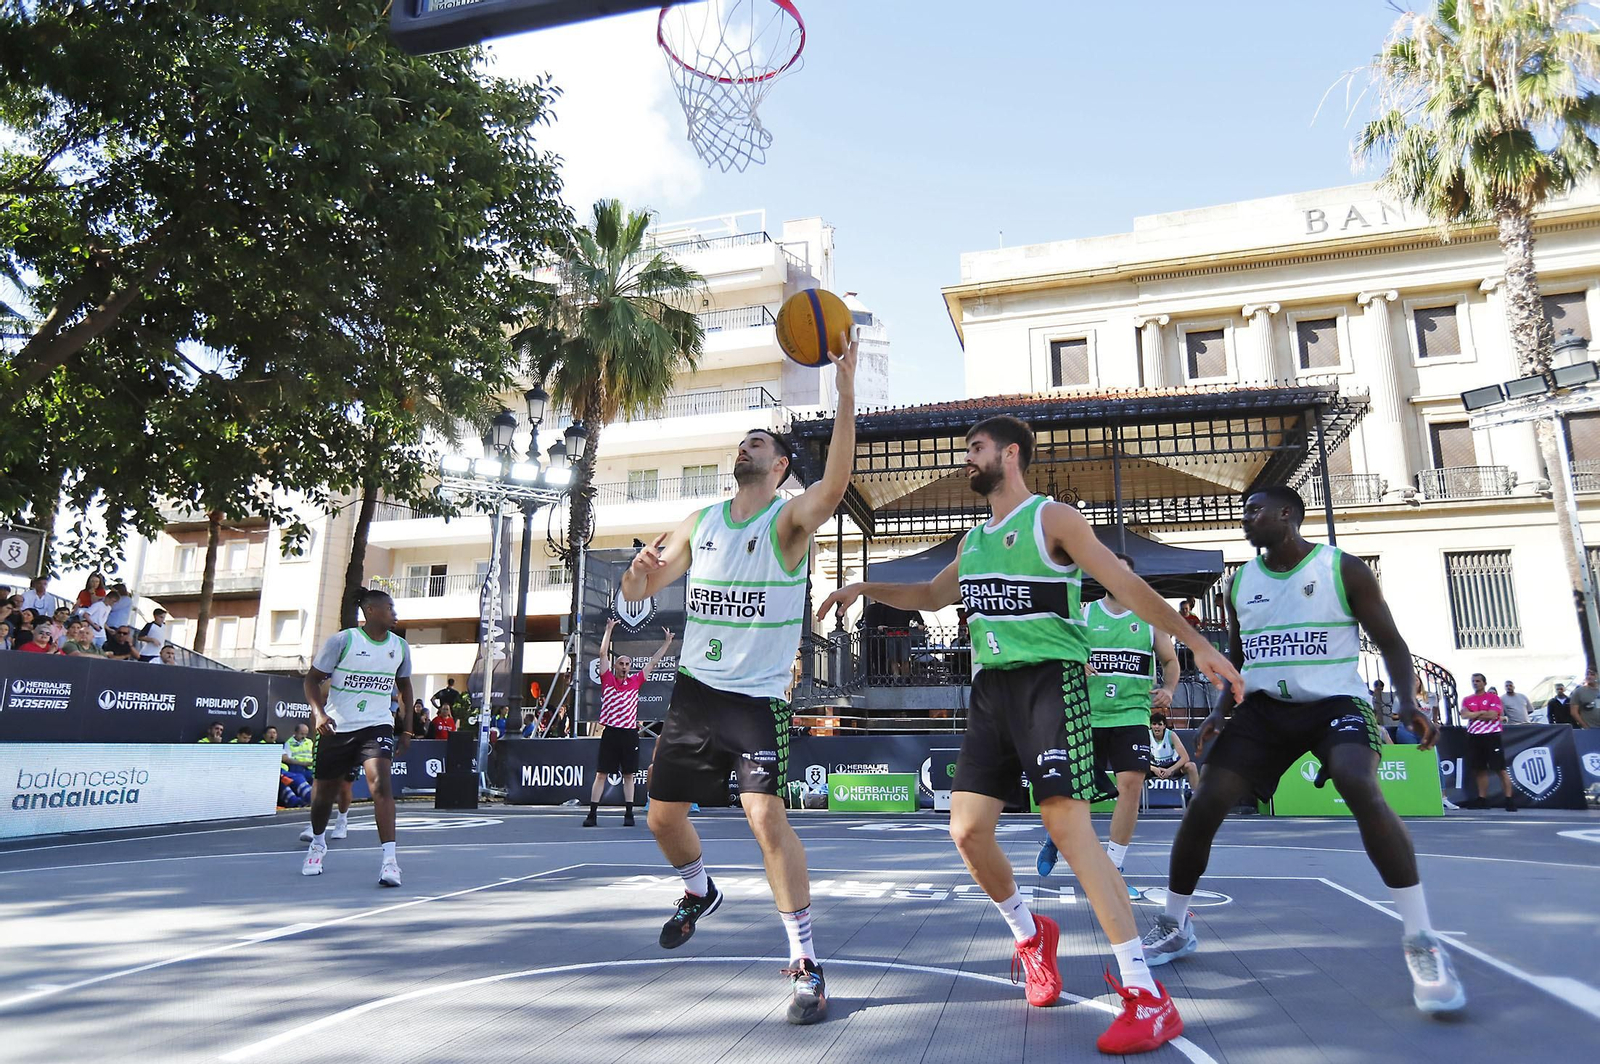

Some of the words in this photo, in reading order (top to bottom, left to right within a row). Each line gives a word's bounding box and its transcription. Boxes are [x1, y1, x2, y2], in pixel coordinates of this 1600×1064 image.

[1302, 200, 1406, 235] BAN
[960, 583, 1031, 599] RBALIFE
[986, 631, 1001, 655] 4
[1242, 631, 1328, 649] HERBALIFE
[705, 638, 723, 662] 3
[1243, 644, 1328, 660] NUTRITION
[25, 687, 71, 696] NUTRITION
[26, 681, 72, 690] HERBALIFE
[1105, 684, 1116, 697] 3
[1276, 680, 1292, 699] 1
[117, 691, 176, 703] HERBALIFE
[195, 697, 239, 709] AMBILAMP
[8, 698, 69, 710] 3X3SERIES
[116, 700, 175, 711] NUTRITION
[287, 702, 312, 711] HERBA
[356, 700, 367, 712] 4
[287, 710, 311, 718] NUTRI
[17, 767, 149, 790] baloncesto
[522, 765, 584, 787] MADISON
[850, 786, 908, 794] HERBALIFE
[850, 793, 909, 801] NUTRITION
